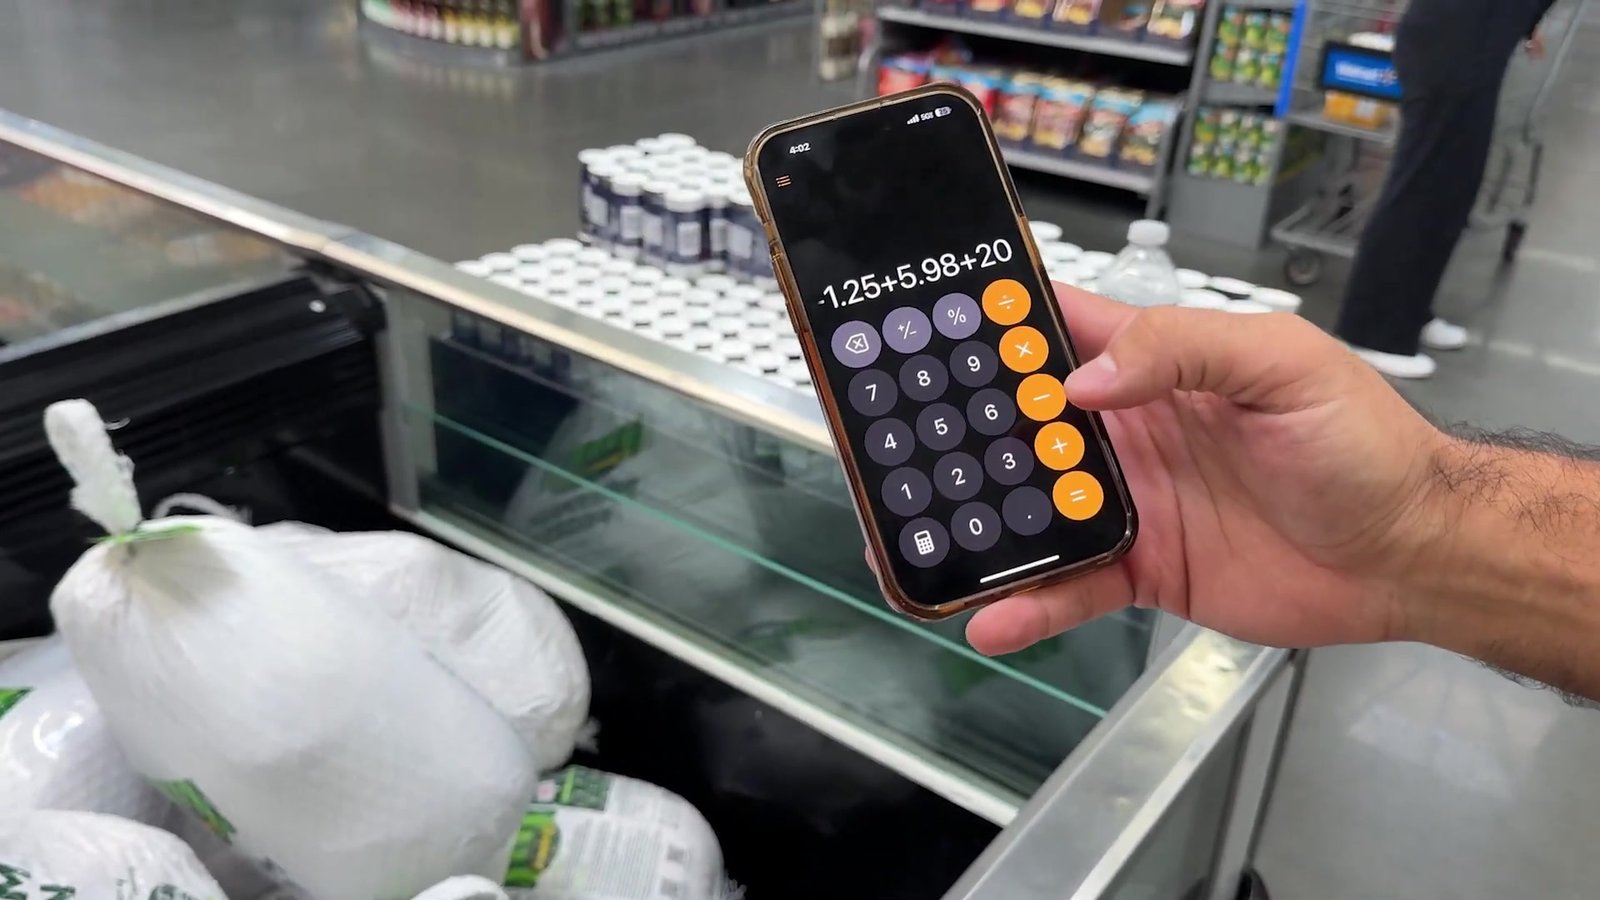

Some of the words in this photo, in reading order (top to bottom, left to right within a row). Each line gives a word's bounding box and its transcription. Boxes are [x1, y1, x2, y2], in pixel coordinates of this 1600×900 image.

[789, 142, 811, 154] 4:02
[947, 306, 967, 326] %
[865, 383, 878, 402] 7
[916, 370, 931, 387] 8
[966, 355, 981, 372] 9
[884, 432, 898, 450] 4
[934, 418, 948, 435] 5
[984, 403, 998, 420] 6
[900, 483, 912, 500] 1
[951, 468, 966, 485] 2
[1002, 452, 1016, 469] 3
[968, 518, 983, 535] 0
